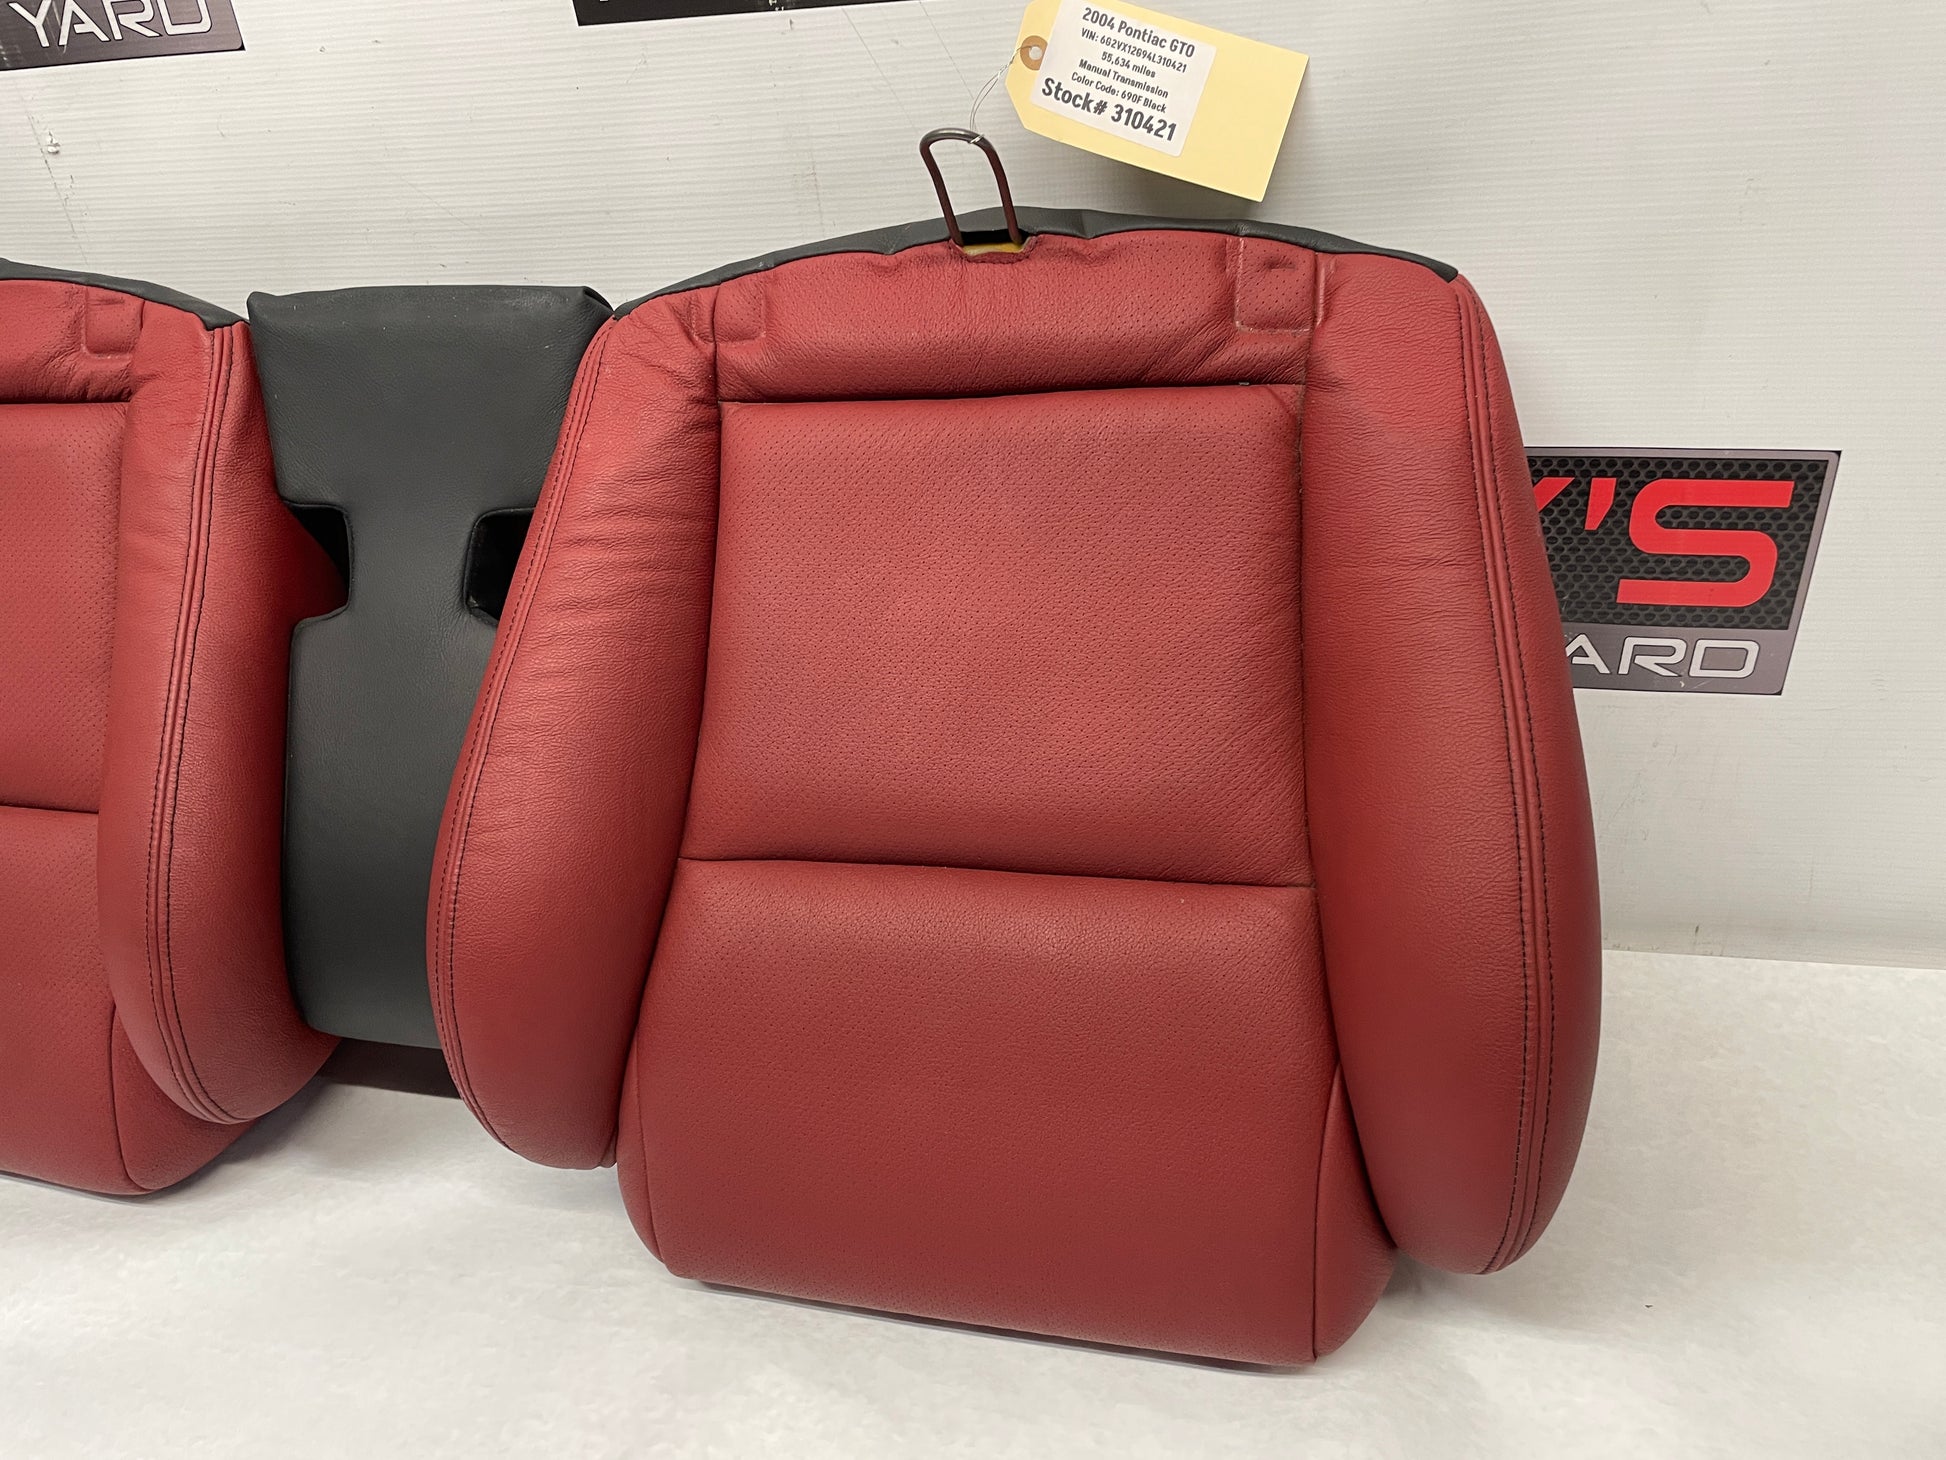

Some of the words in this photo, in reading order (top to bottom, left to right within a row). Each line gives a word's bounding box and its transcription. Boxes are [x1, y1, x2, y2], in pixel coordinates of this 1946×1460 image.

[8, 0, 212, 47] YARD
[1081, 27, 1099, 42] VIN:
[1082, 7, 1115, 30] 2004
[1118, 20, 1167, 48] Pontiac
[1169, 39, 1195, 58] GTO
[1079, 59, 1111, 78] Manual
[1113, 71, 1168, 98] Transmission
[1101, 51, 1131, 69] 55,634
[1132, 61, 1156, 78] miles
[1042, 77, 1107, 116] Stock#
[1111, 103, 1177, 141] 310421
[1071, 71, 1094, 88] Color
[1095, 81, 1119, 97] Code:
[1121, 91, 1143, 104] 690F
[1143, 99, 1167, 114] Black
